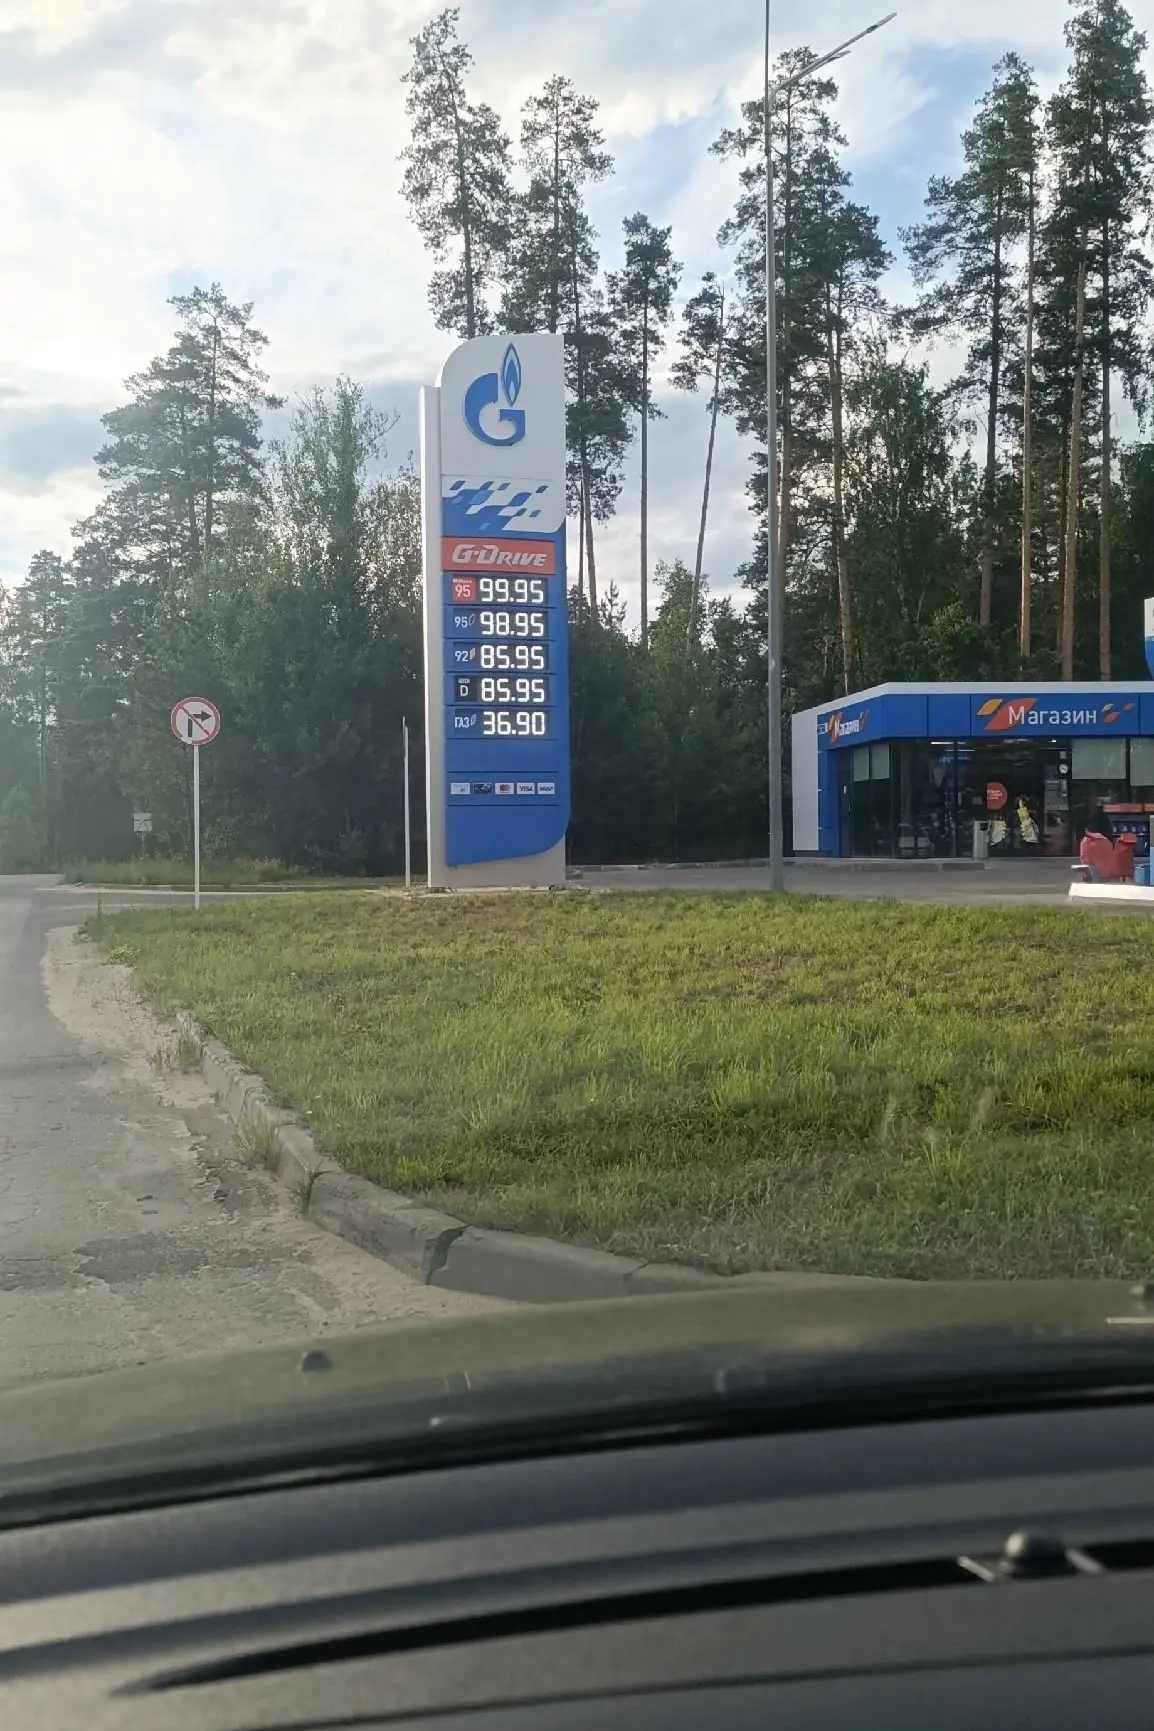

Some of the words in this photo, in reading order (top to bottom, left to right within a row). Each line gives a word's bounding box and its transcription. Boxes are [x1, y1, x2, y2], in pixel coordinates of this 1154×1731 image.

[455, 584, 471, 598] 95
[479, 578, 544, 603] 99.95
[454, 616, 468, 628] 95
[480, 611, 545, 637] 98.95
[454, 650, 469, 662] 92
[480, 645, 545, 669] 85.95
[459, 684, 469, 697] D
[481, 677, 545, 703] 85.95
[454, 716, 470, 728] ГАЗ
[483, 711, 545, 736] 36.90
[1008, 705, 1097, 725] Магазин
